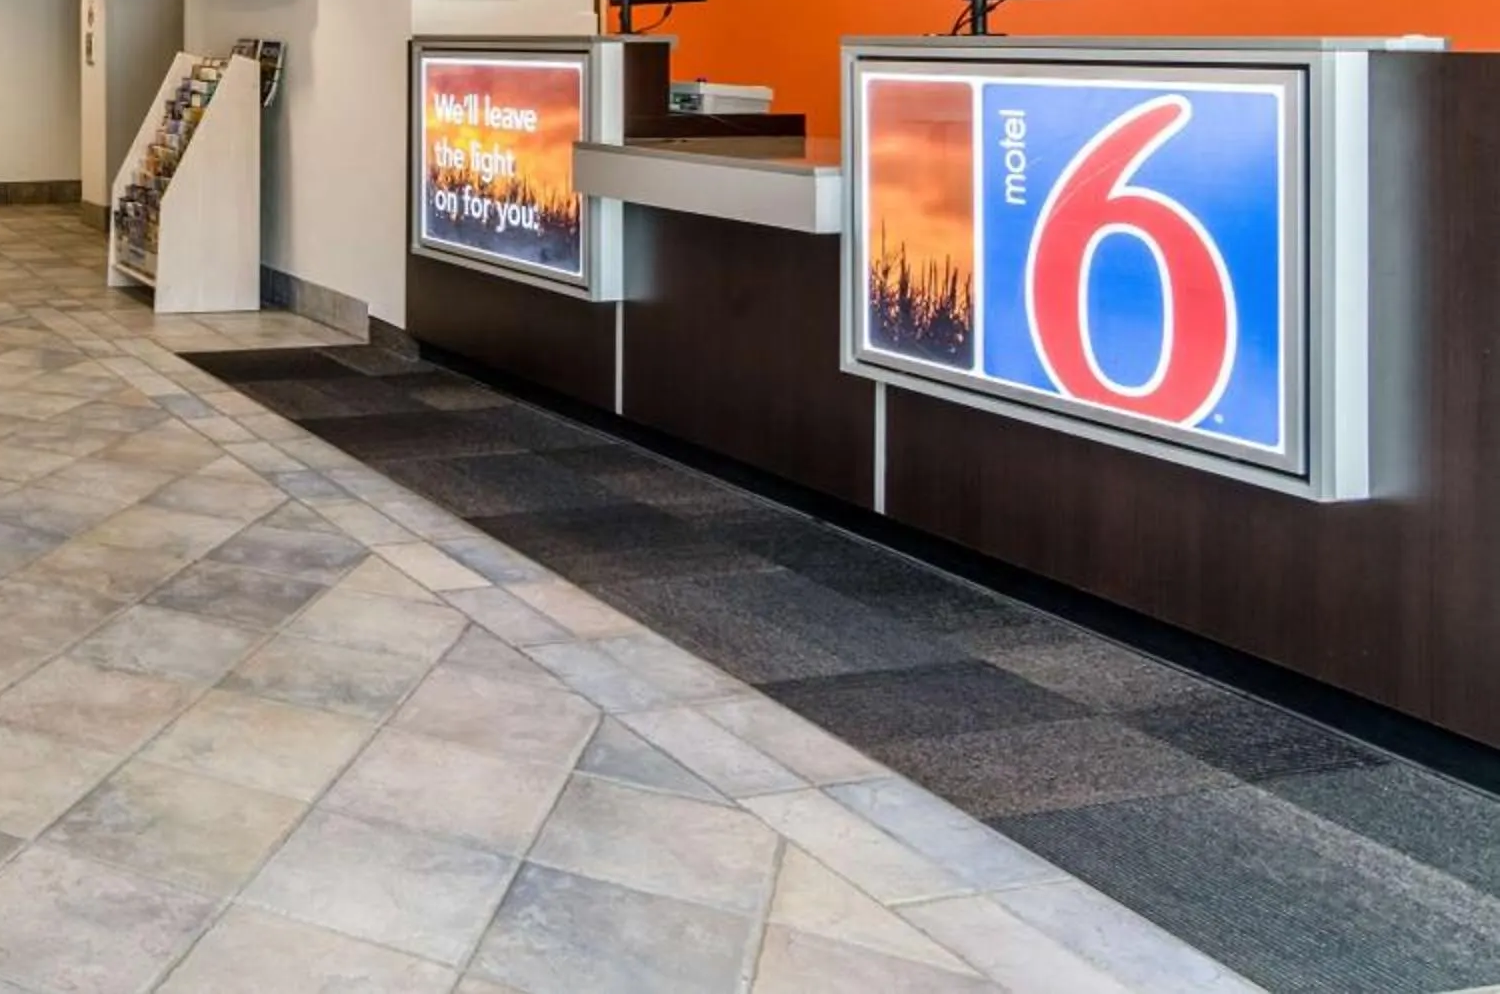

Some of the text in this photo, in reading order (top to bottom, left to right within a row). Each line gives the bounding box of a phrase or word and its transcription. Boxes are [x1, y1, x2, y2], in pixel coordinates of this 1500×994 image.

[434, 93, 537, 132] We'll leave
[434, 137, 515, 183] the light
[435, 190, 457, 215] on
[463, 185, 493, 223] for
[999, 94, 1237, 428] motel 6
